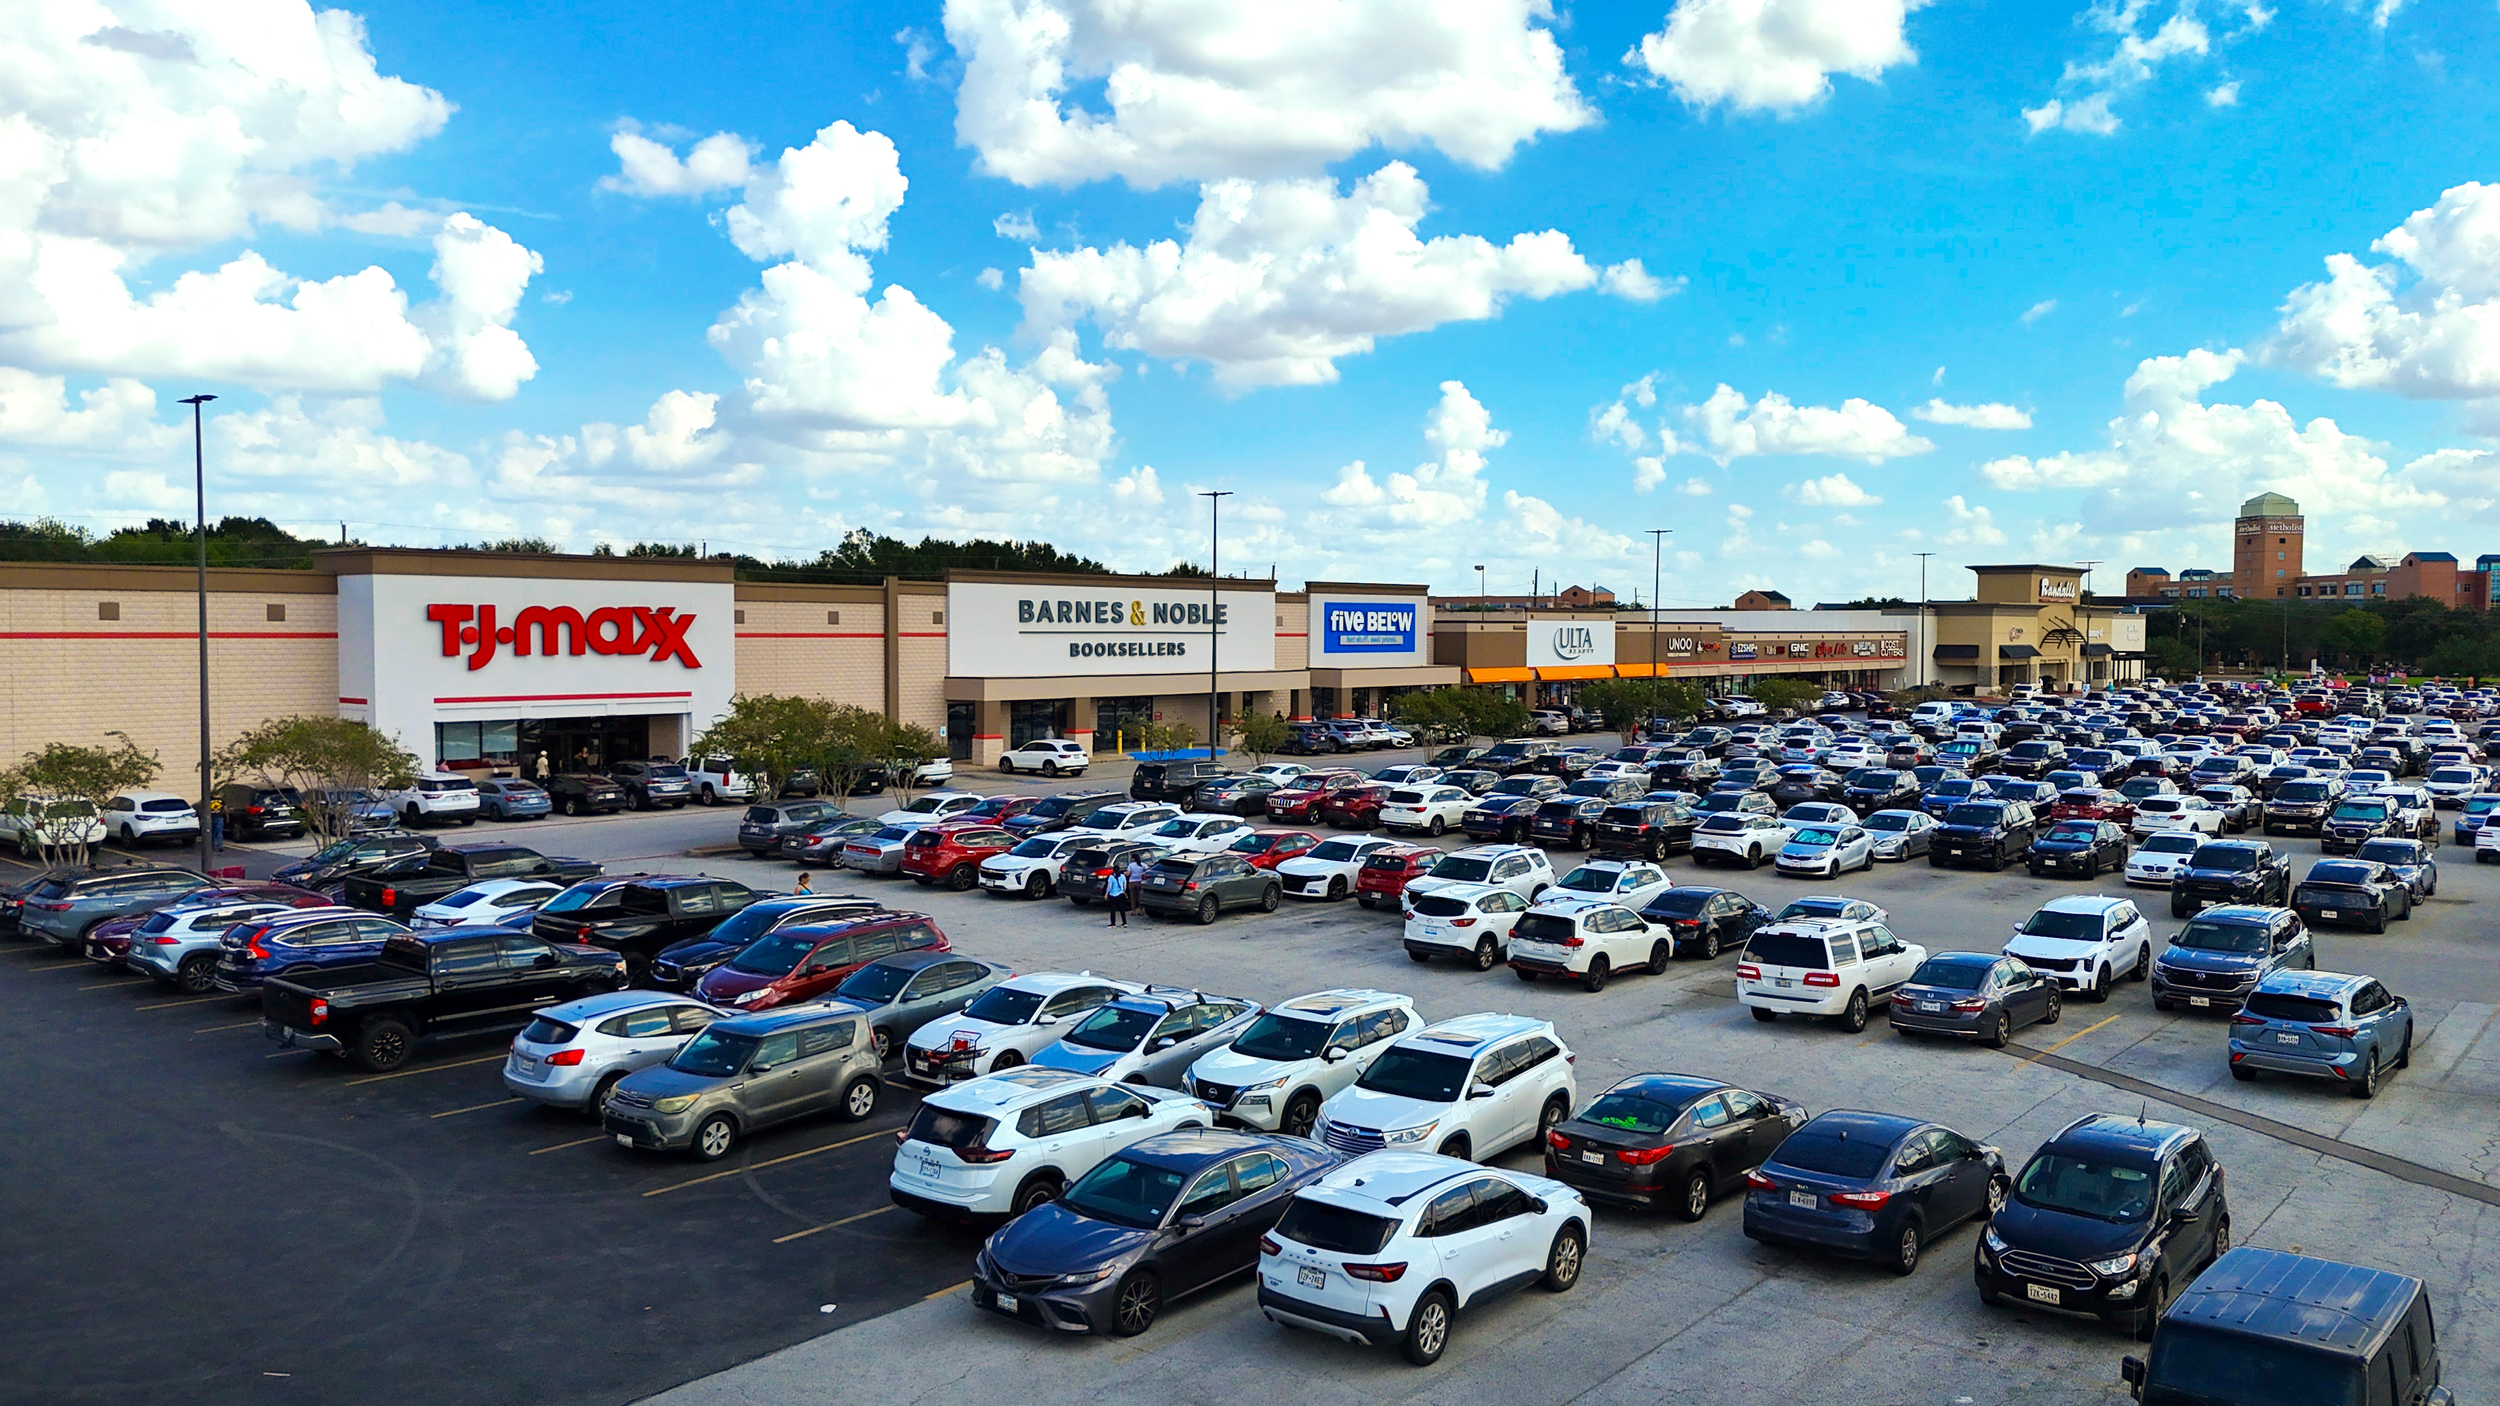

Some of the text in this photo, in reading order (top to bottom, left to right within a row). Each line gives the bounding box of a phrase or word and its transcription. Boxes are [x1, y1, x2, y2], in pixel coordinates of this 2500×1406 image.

[2041, 577, 2075, 598] Randalls
[1018, 600, 1228, 626] BARNES & NOBLE
[1559, 627, 1593, 649] ULTA
[1668, 637, 1692, 651] UNOO
[1069, 642, 1186, 657] BOOKSELLERS
[1790, 643, 1810, 652] GNC
